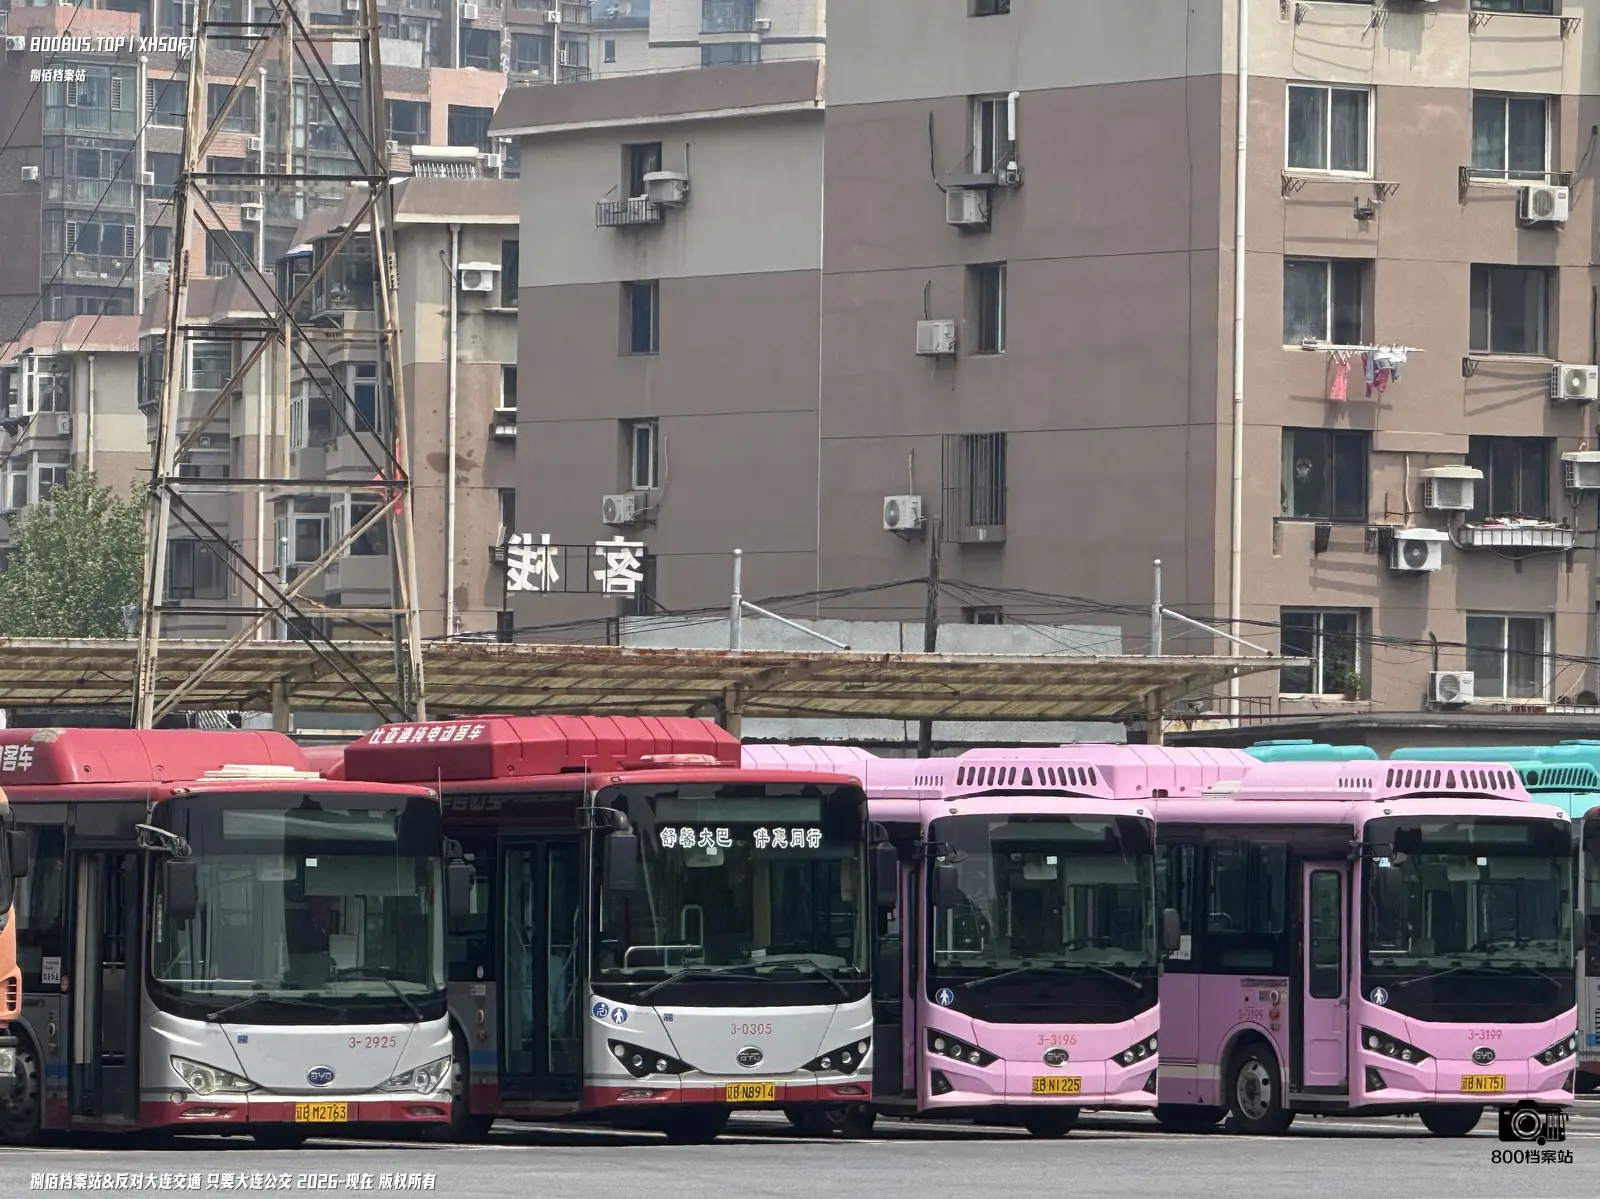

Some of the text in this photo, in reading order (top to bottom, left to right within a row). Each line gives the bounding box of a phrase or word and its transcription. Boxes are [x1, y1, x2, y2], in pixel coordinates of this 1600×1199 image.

[0, 744, 35, 772] 客车
[752, 827, 823, 849] 伴您同行
[730, 1023, 773, 1035] 3-0305
[1467, 1029, 1503, 1041] 3-3199
[348, 1036, 397, 1049] 3-2925
[1037, 1034, 1077, 1046] 3-3196
